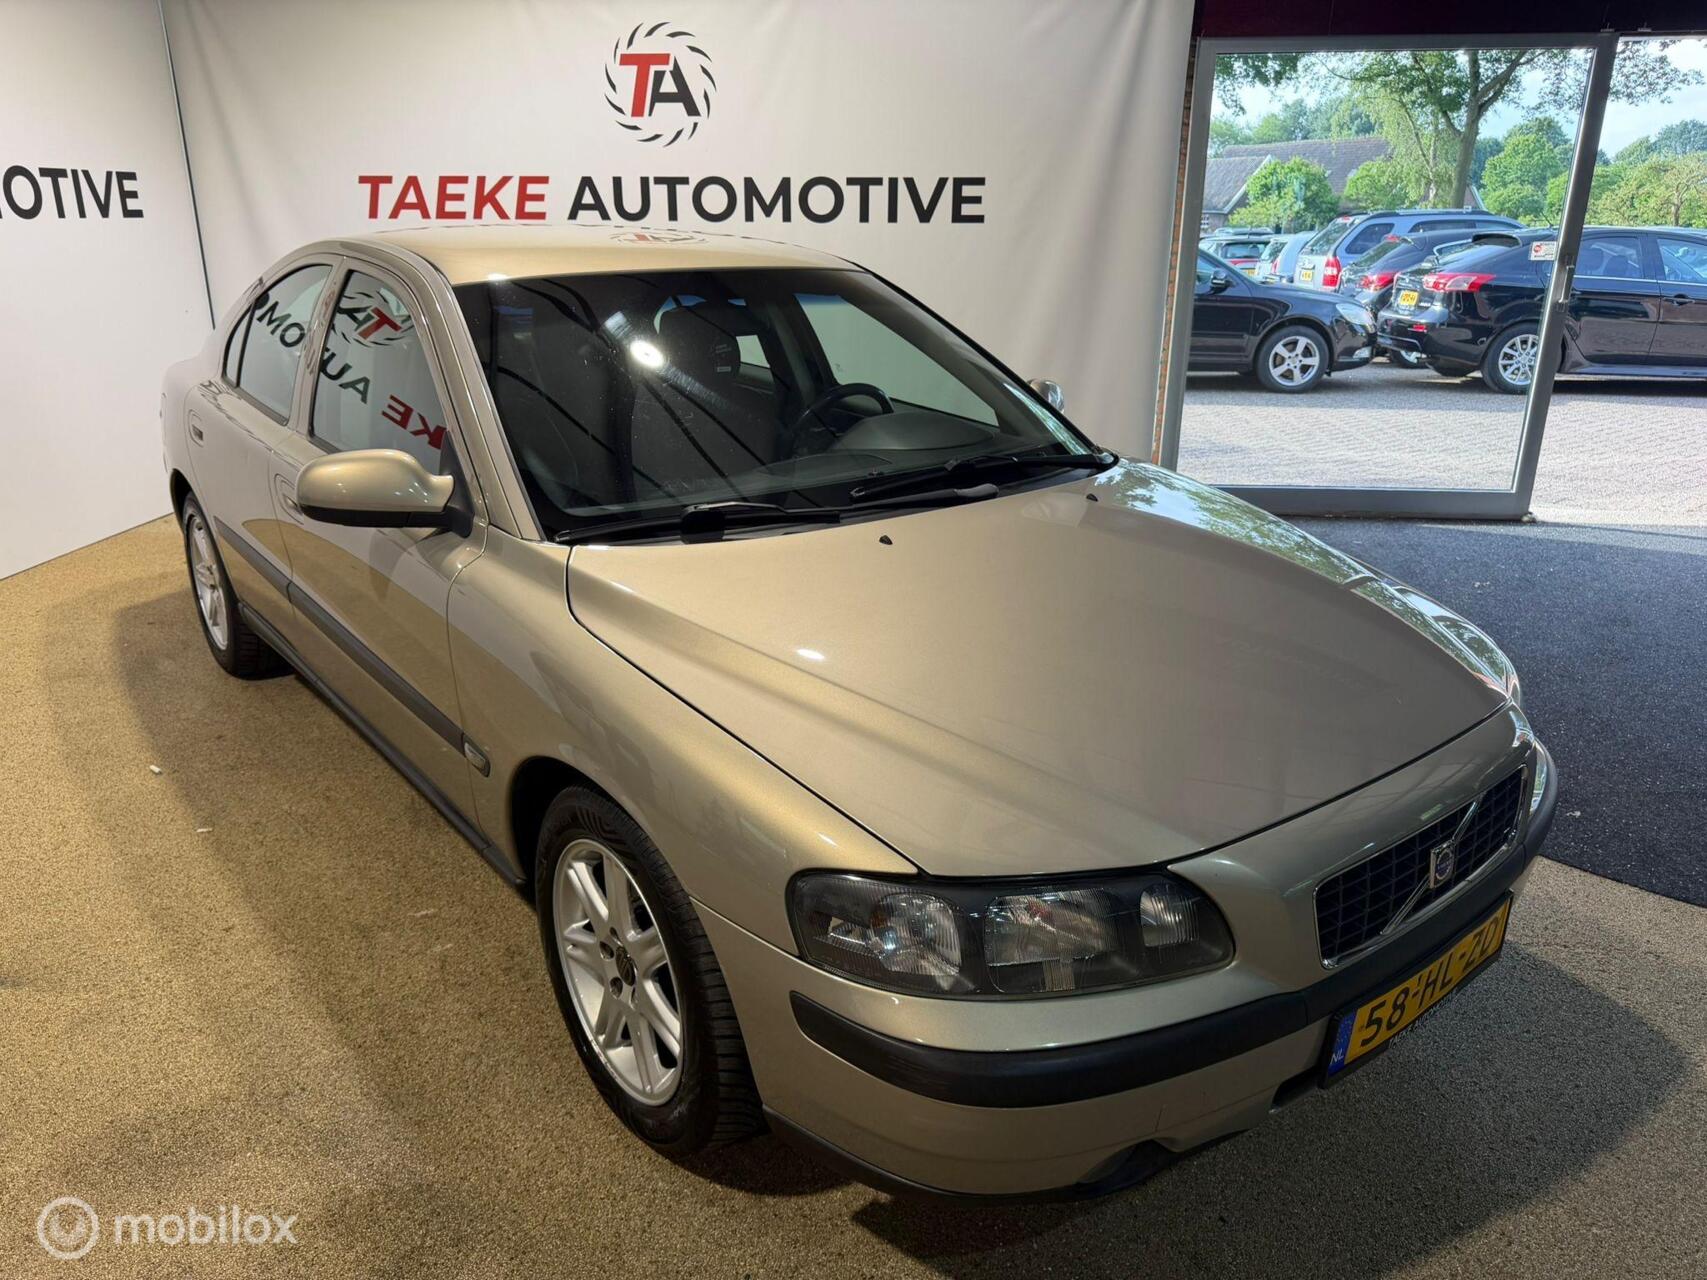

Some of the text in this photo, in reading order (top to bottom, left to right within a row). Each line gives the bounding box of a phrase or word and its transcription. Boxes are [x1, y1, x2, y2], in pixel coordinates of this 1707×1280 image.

[619, 53, 702, 118] TA
[0, 165, 144, 220] OTIVE
[359, 176, 986, 224] TAEKE AUTOMOTIVE
[1330, 1048, 1344, 1065] NL
